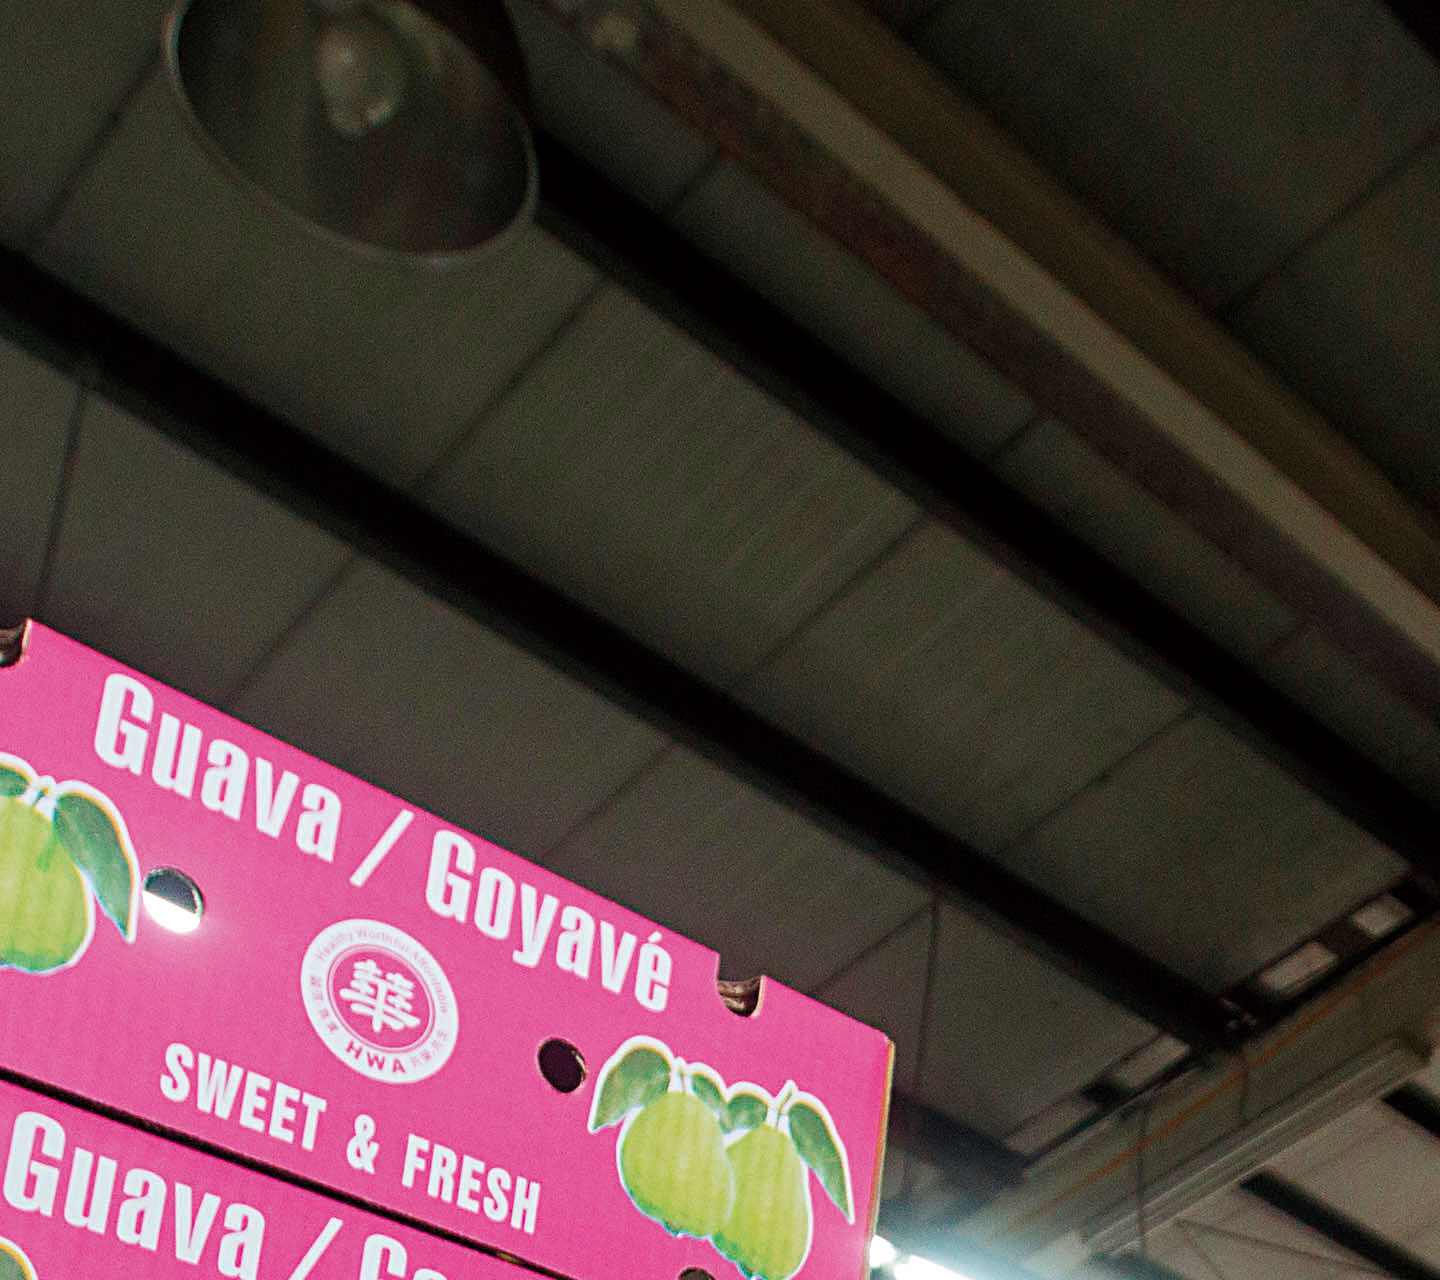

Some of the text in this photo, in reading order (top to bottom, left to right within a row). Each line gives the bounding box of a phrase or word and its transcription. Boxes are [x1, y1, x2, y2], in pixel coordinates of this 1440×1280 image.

[94, 673, 341, 863] Guava
[426, 830, 672, 1012] Goyavé
[160, 1043, 540, 1235] SWEET & FRESH
[345, 1040, 406, 1073] HWA
